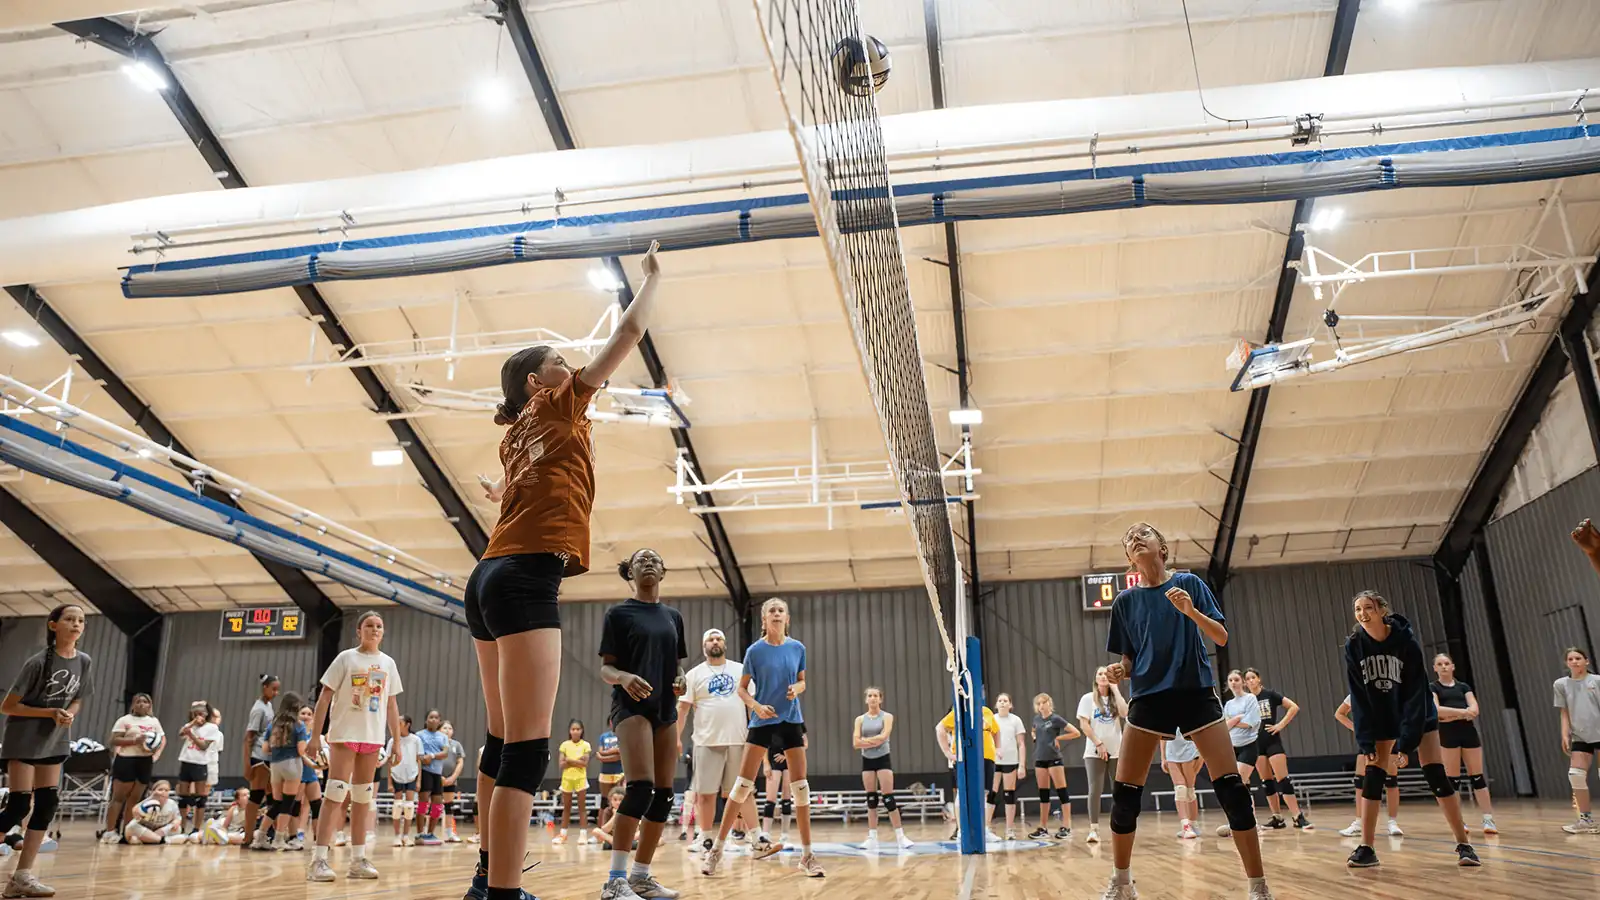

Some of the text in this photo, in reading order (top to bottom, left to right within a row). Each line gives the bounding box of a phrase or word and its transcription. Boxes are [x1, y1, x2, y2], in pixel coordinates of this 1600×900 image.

[1087, 576, 1113, 584] GUEST
[1101, 584, 1112, 600] 0
[228, 617, 243, 632] 70
[264, 626, 272, 636] 2
[282, 616, 299, 631] 82
